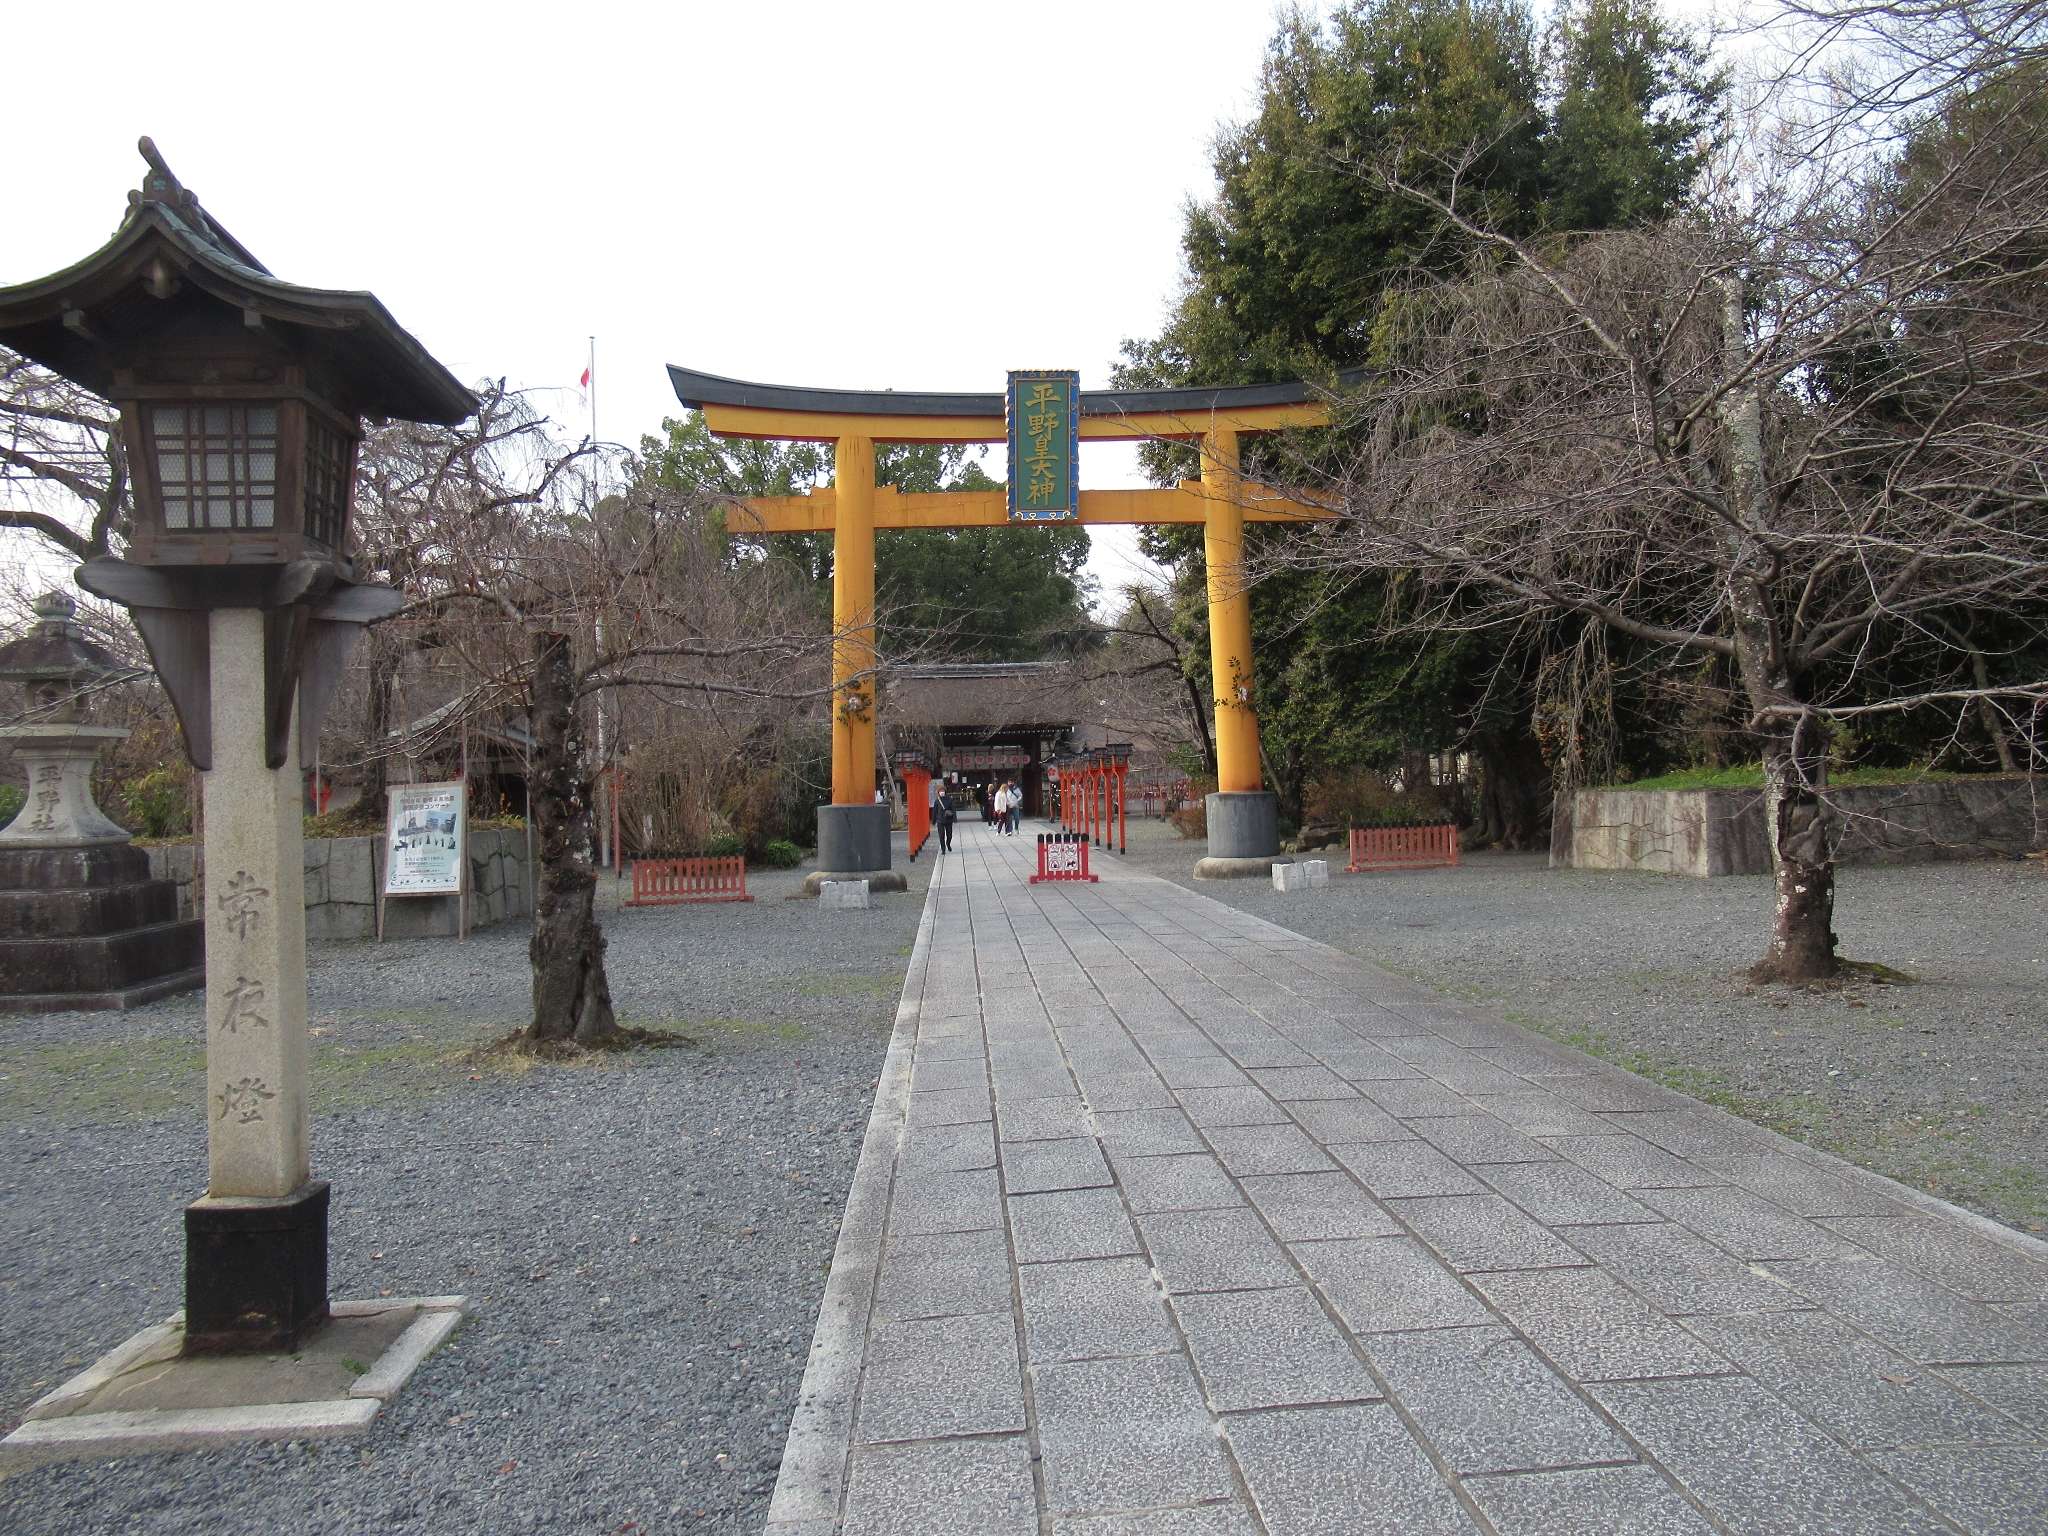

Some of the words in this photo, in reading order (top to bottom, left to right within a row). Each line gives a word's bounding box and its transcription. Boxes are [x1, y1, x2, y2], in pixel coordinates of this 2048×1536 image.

[1024, 383, 1062, 506] 平野皇大神
